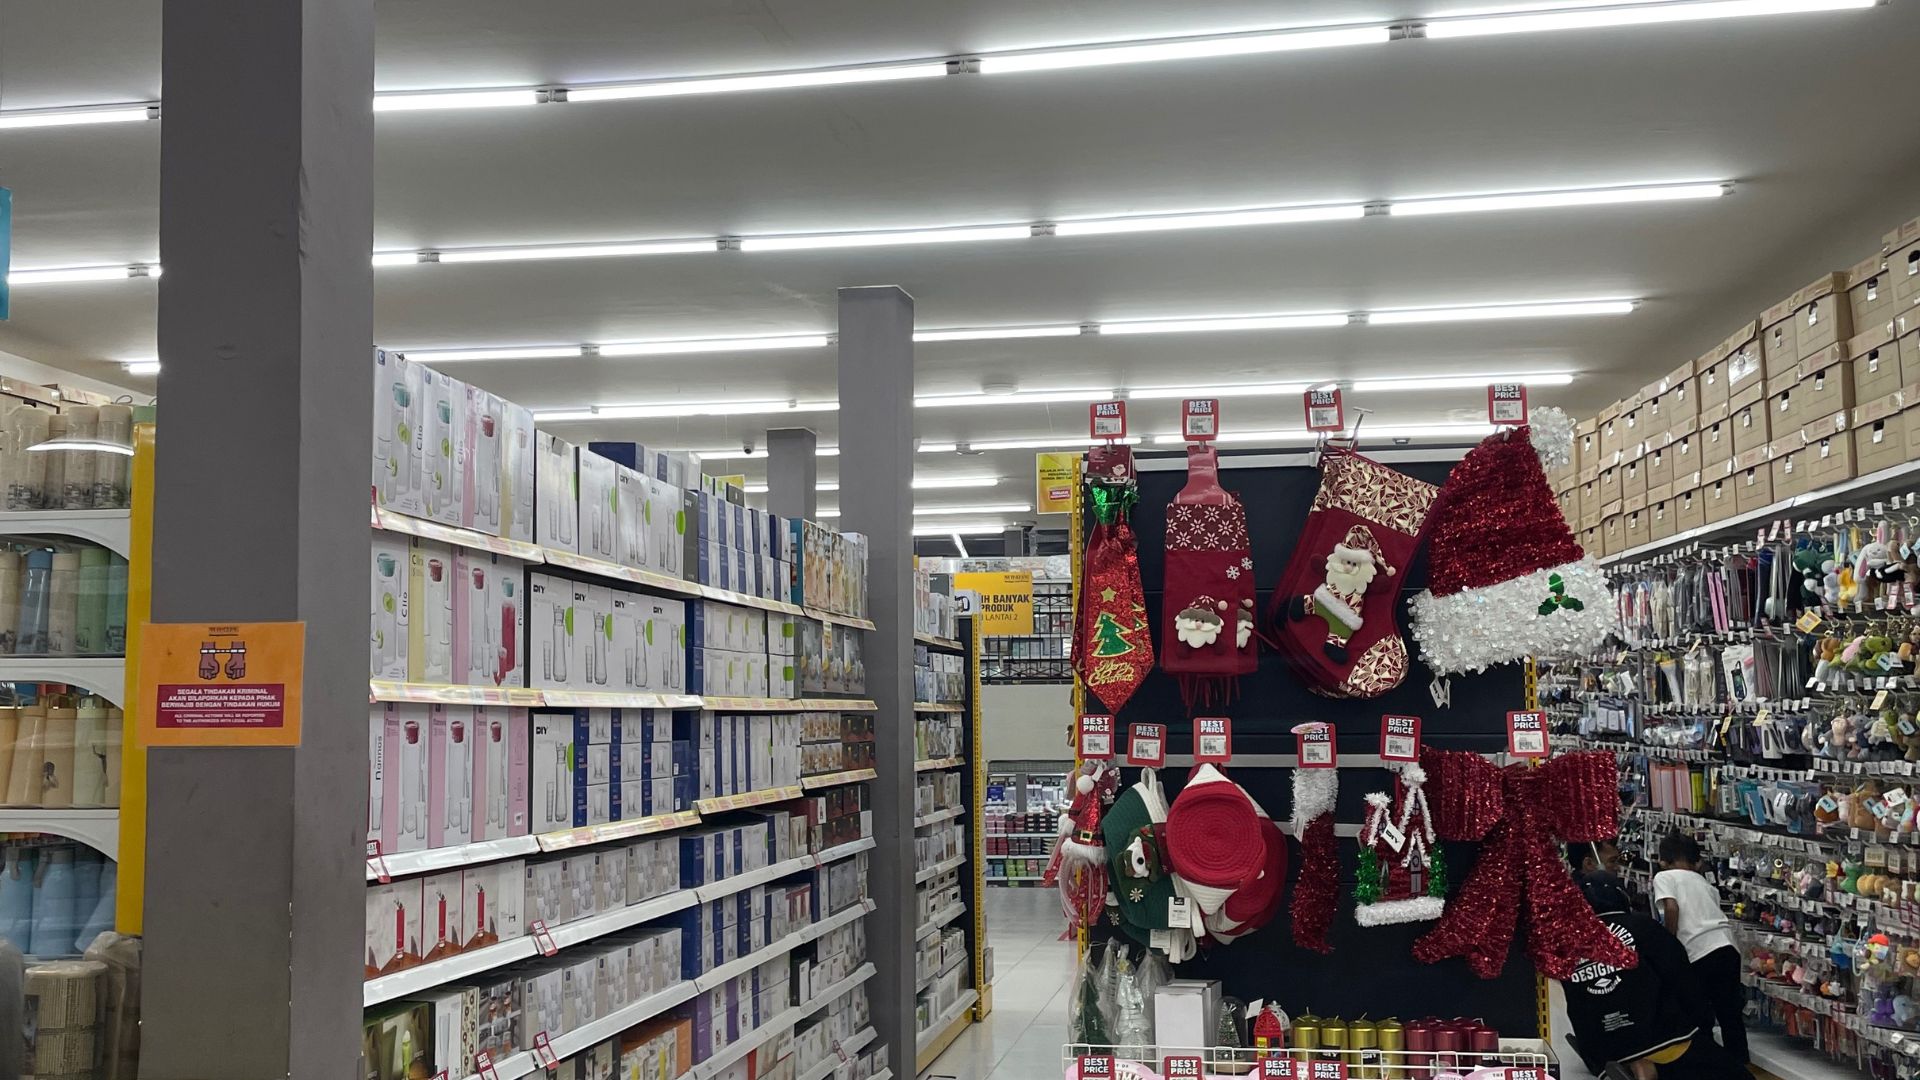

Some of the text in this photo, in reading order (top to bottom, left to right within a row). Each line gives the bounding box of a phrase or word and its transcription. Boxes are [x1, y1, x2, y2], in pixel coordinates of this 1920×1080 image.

[1311, 392, 1333, 400] BEST
[533, 584, 545, 594] DIY
[575, 593, 586, 601] DIY
[994, 594, 1030, 603] BANYAK
[1389, 718, 1415, 726] BEST
[1388, 726, 1414, 734] PRICE
